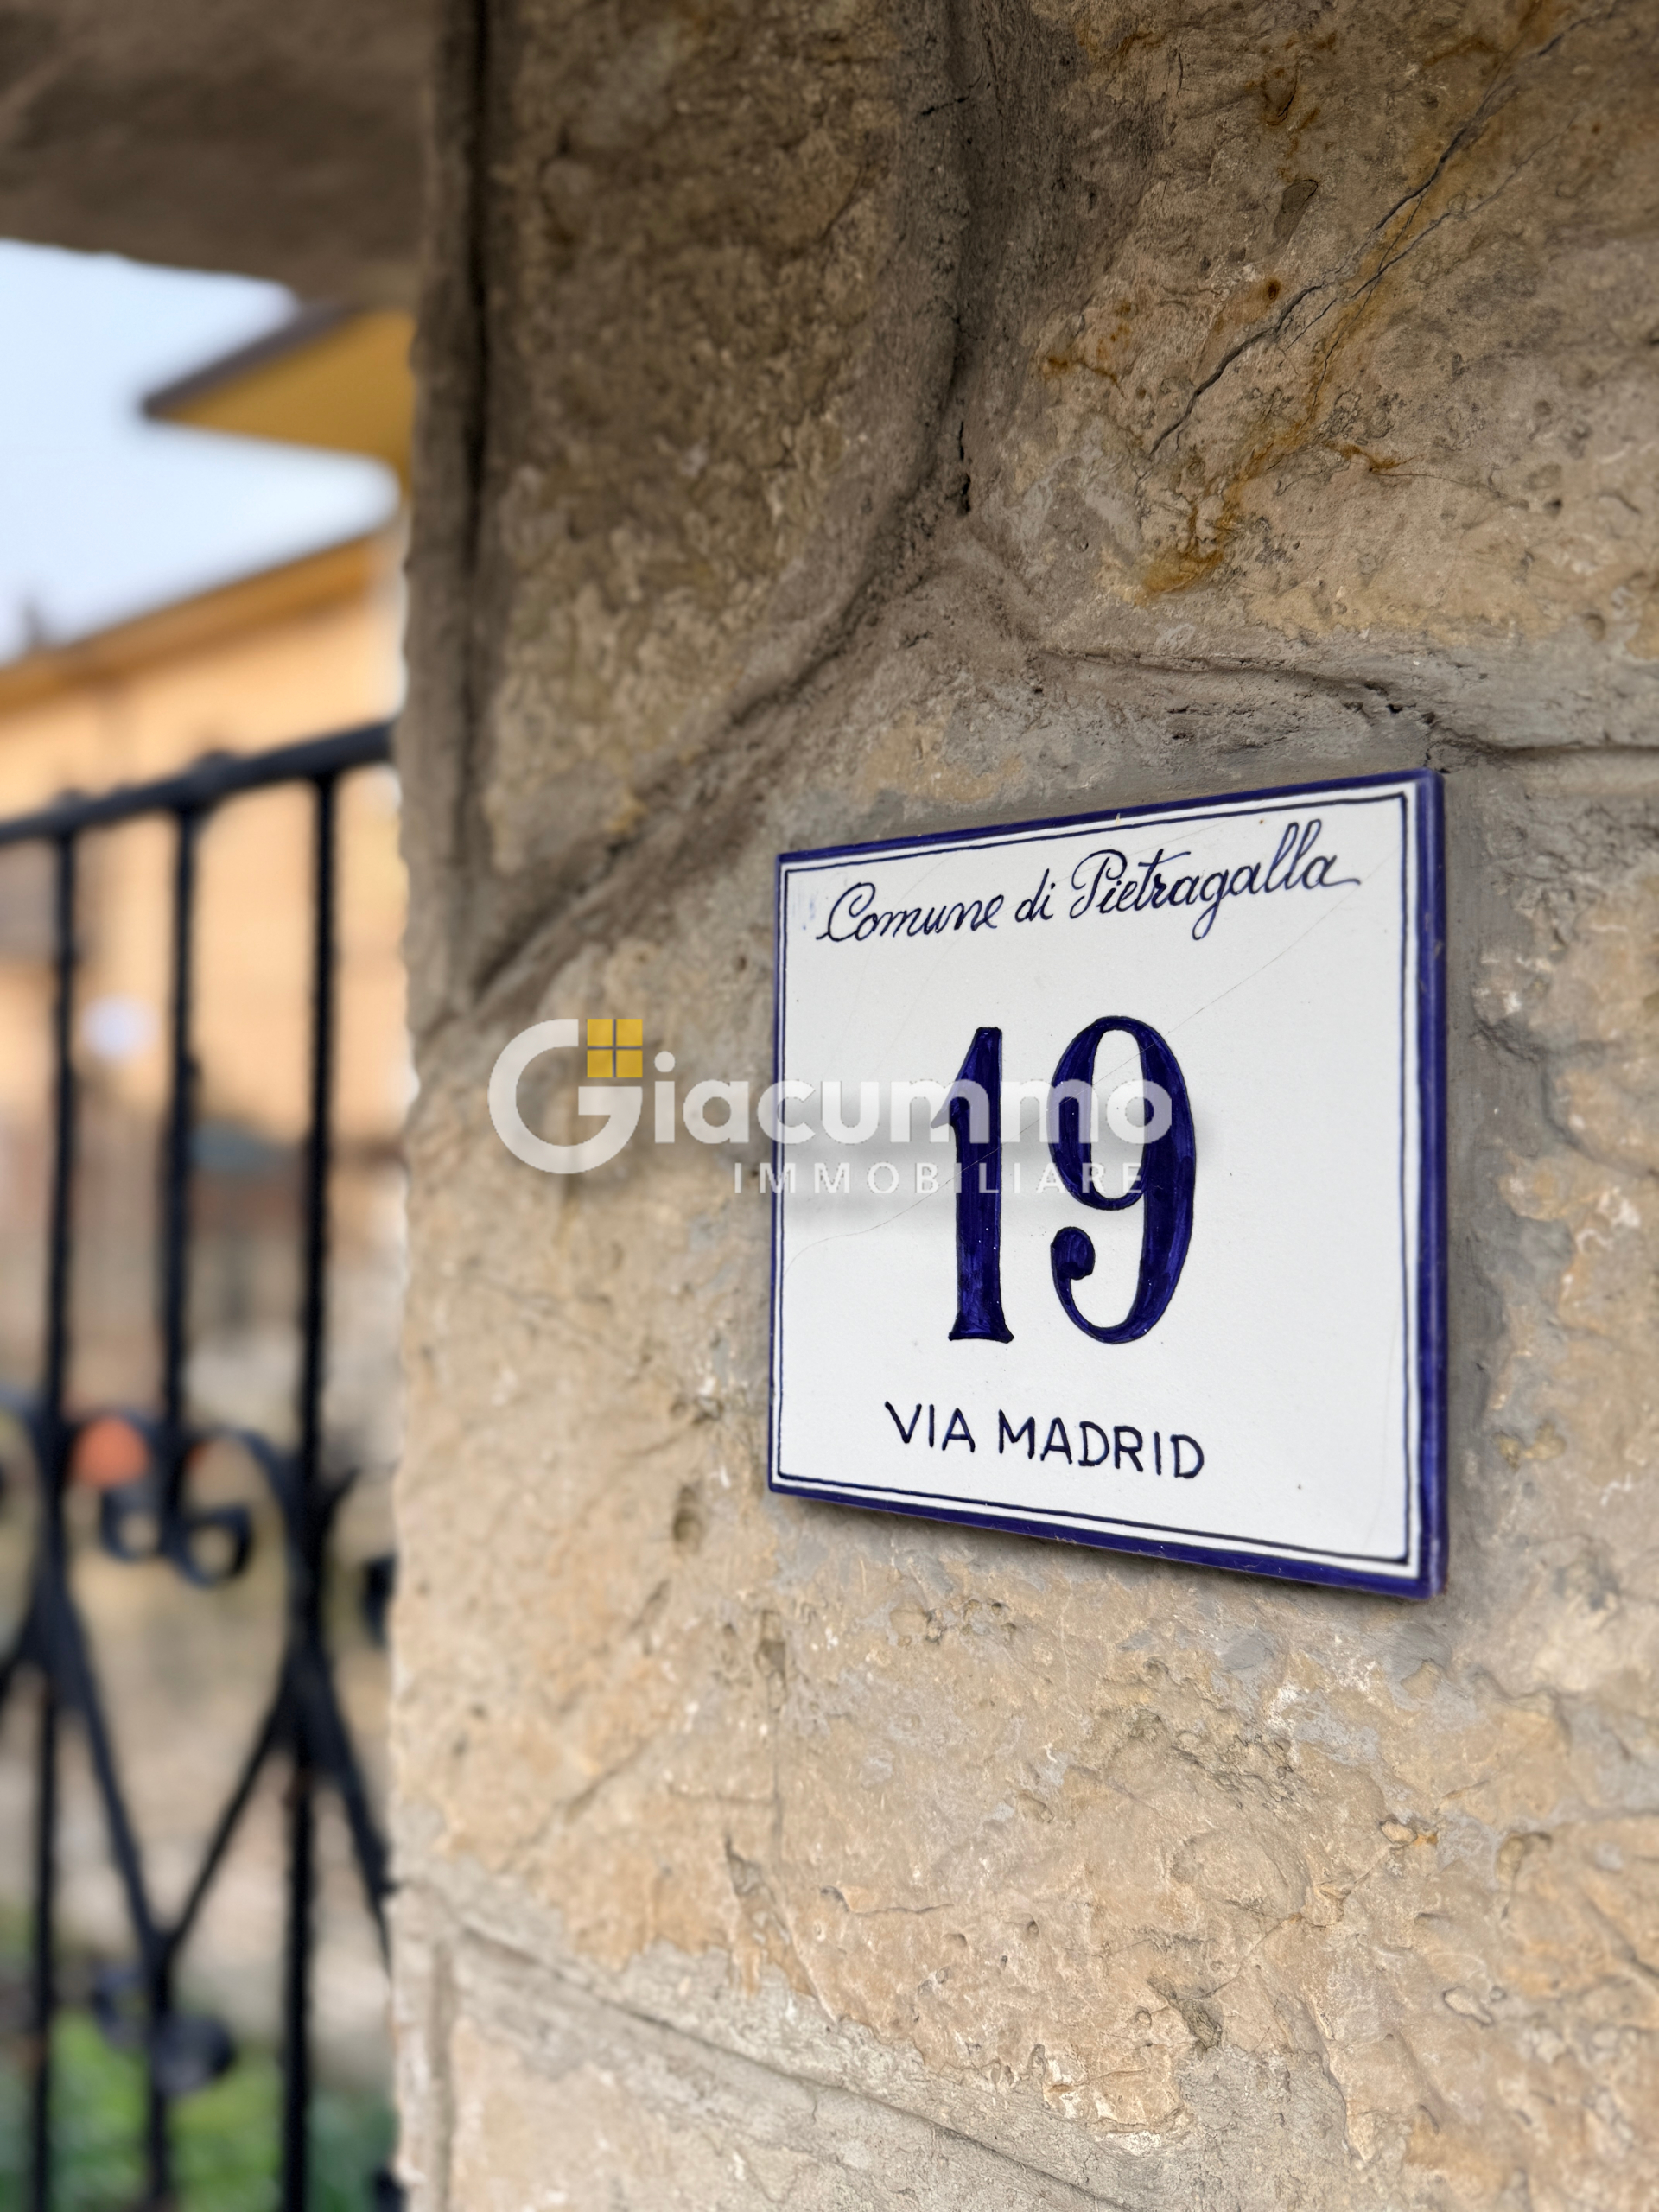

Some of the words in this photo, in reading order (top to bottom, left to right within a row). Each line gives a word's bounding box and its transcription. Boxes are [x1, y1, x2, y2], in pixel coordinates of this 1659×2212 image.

[816, 882, 1002, 942] Comune
[1014, 868, 1054, 923] di
[1069, 818, 1361, 941] Pietragalla
[930, 1015, 1197, 1344] 19
[884, 1401, 976, 1453] VIA
[998, 1408, 1205, 1479] MADRID
